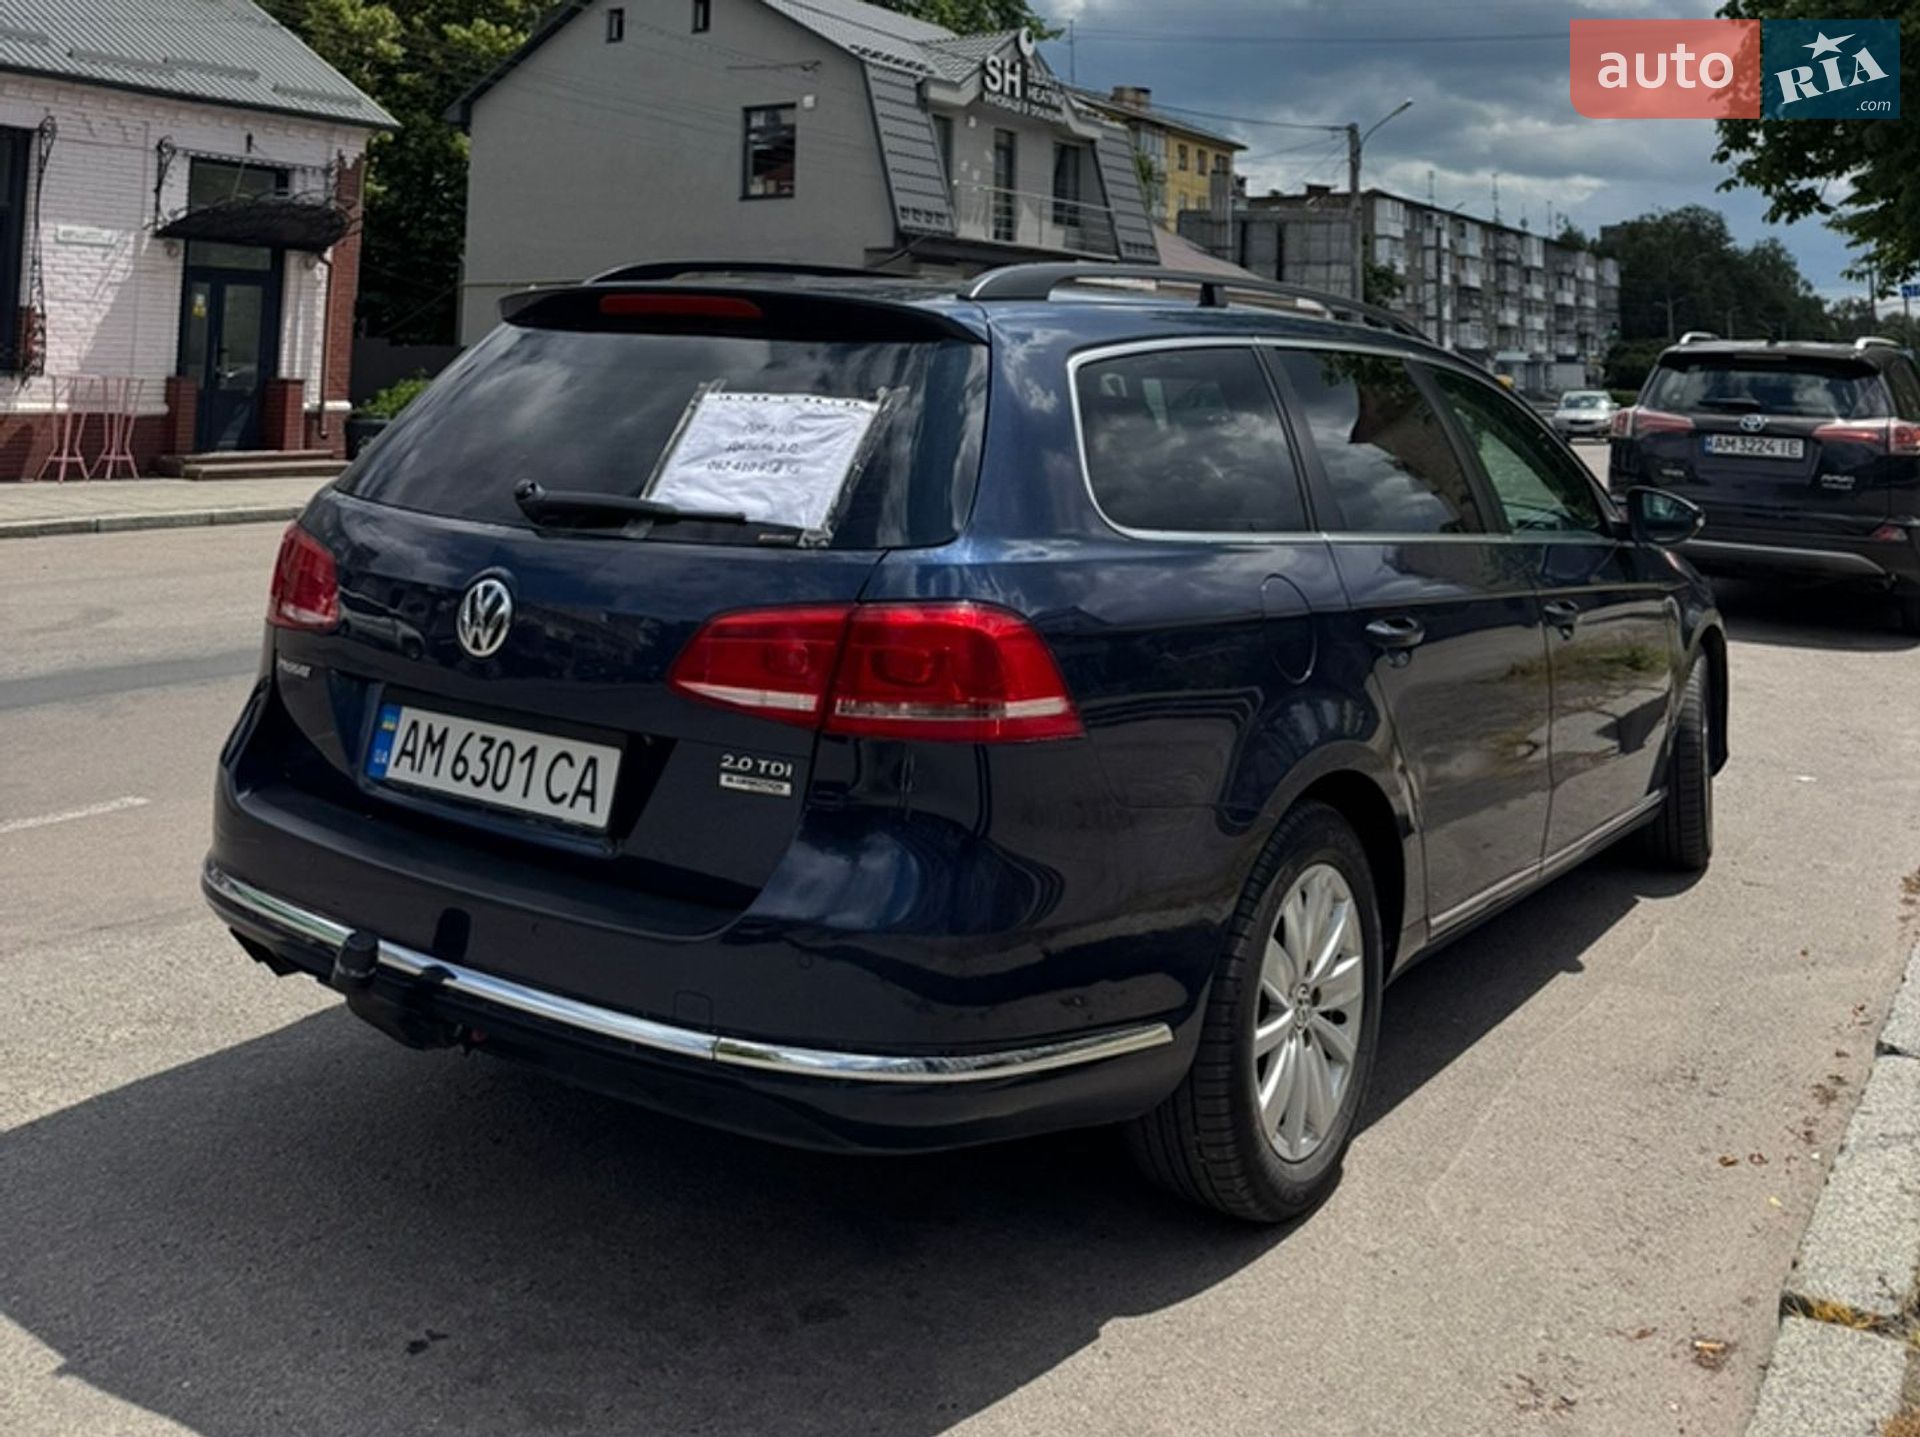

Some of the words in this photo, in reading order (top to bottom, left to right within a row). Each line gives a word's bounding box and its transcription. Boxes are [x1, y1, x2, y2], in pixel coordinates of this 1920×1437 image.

[984, 55, 1022, 98] SH
[394, 719, 449, 778] AM
[450, 731, 538, 799] 6301
[545, 750, 599, 814] CA
[720, 753, 753, 771] 2.0
[757, 759, 793, 778] TDI
